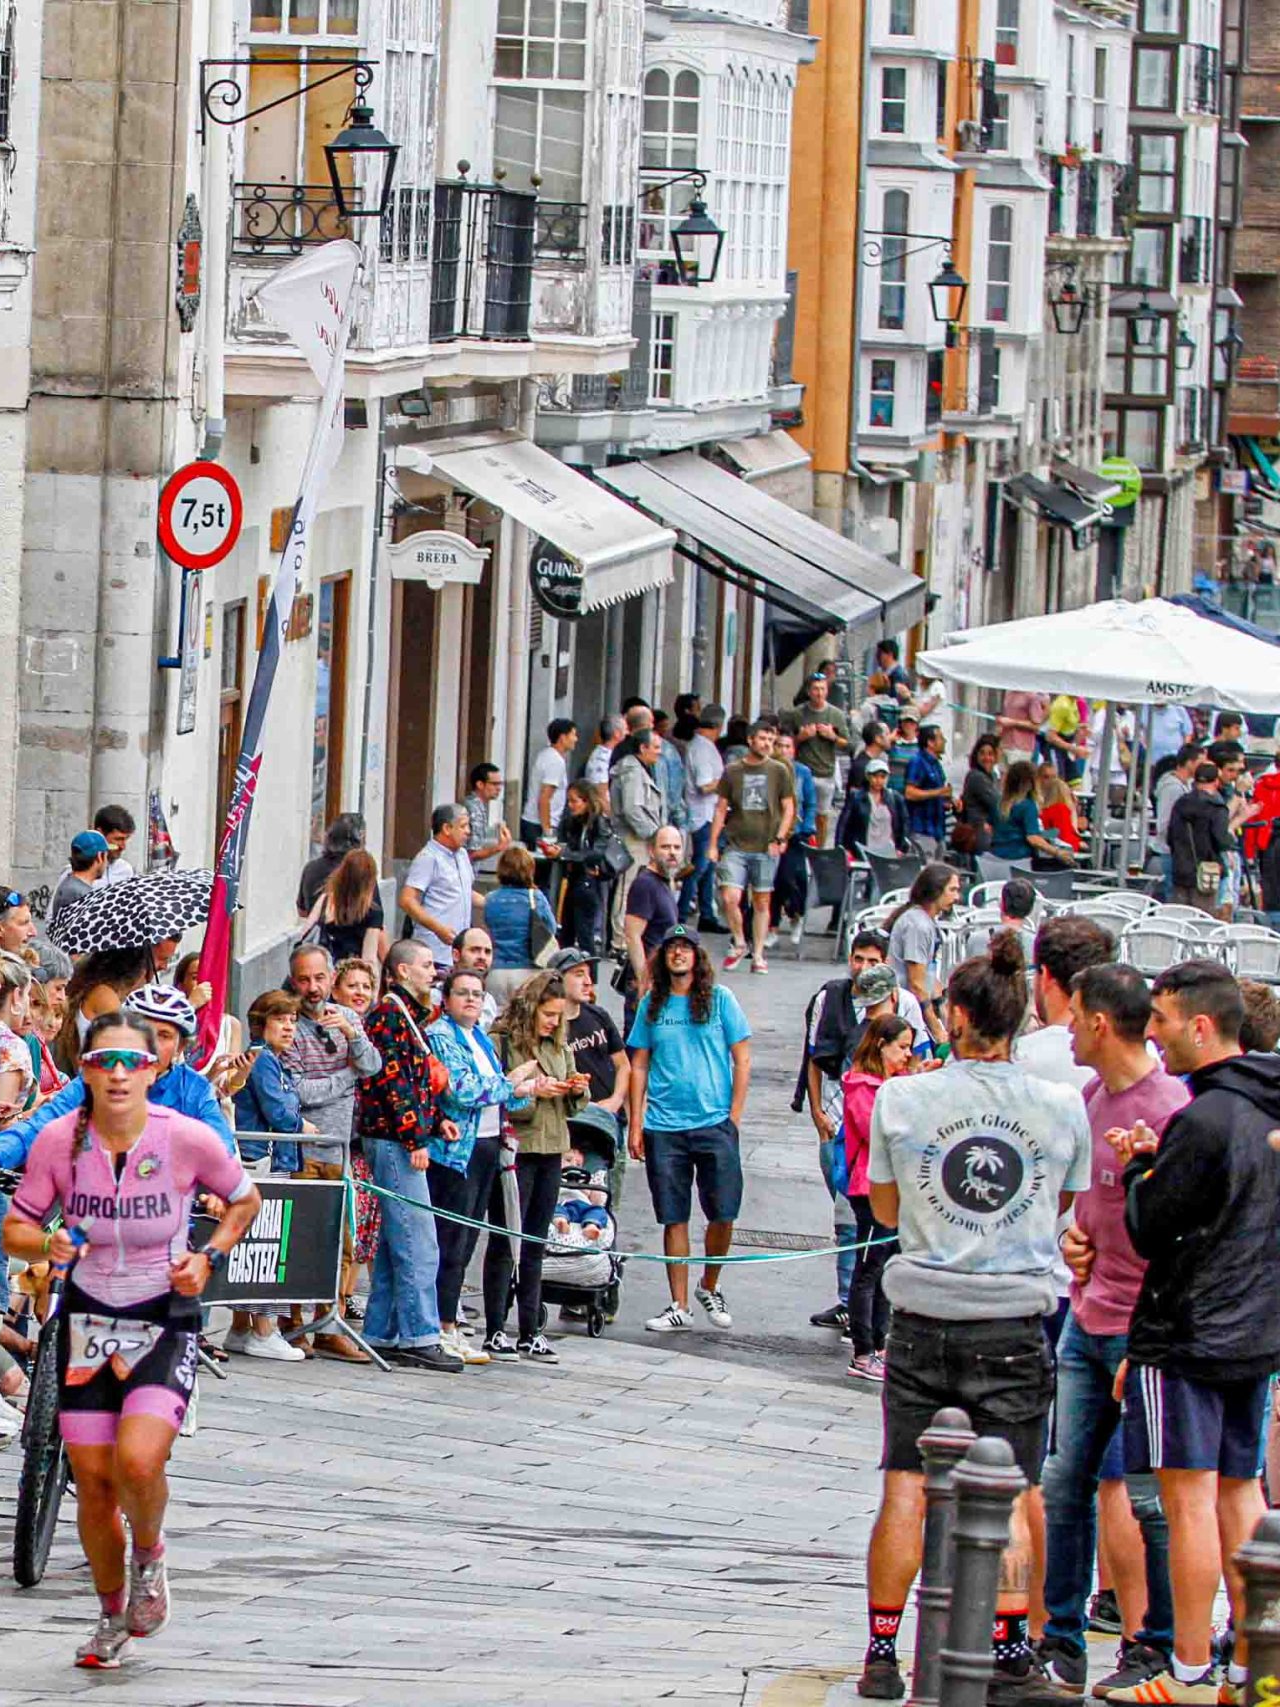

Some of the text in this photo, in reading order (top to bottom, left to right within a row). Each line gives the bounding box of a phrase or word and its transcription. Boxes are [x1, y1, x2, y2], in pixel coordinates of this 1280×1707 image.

[180, 497, 226, 536] 7,5t
[416, 551, 459, 565] BREDA
[981, 1113, 1030, 1139] Globe
[66, 1191, 172, 1220] JORQUERA
[245, 1198, 284, 1240] ORIA
